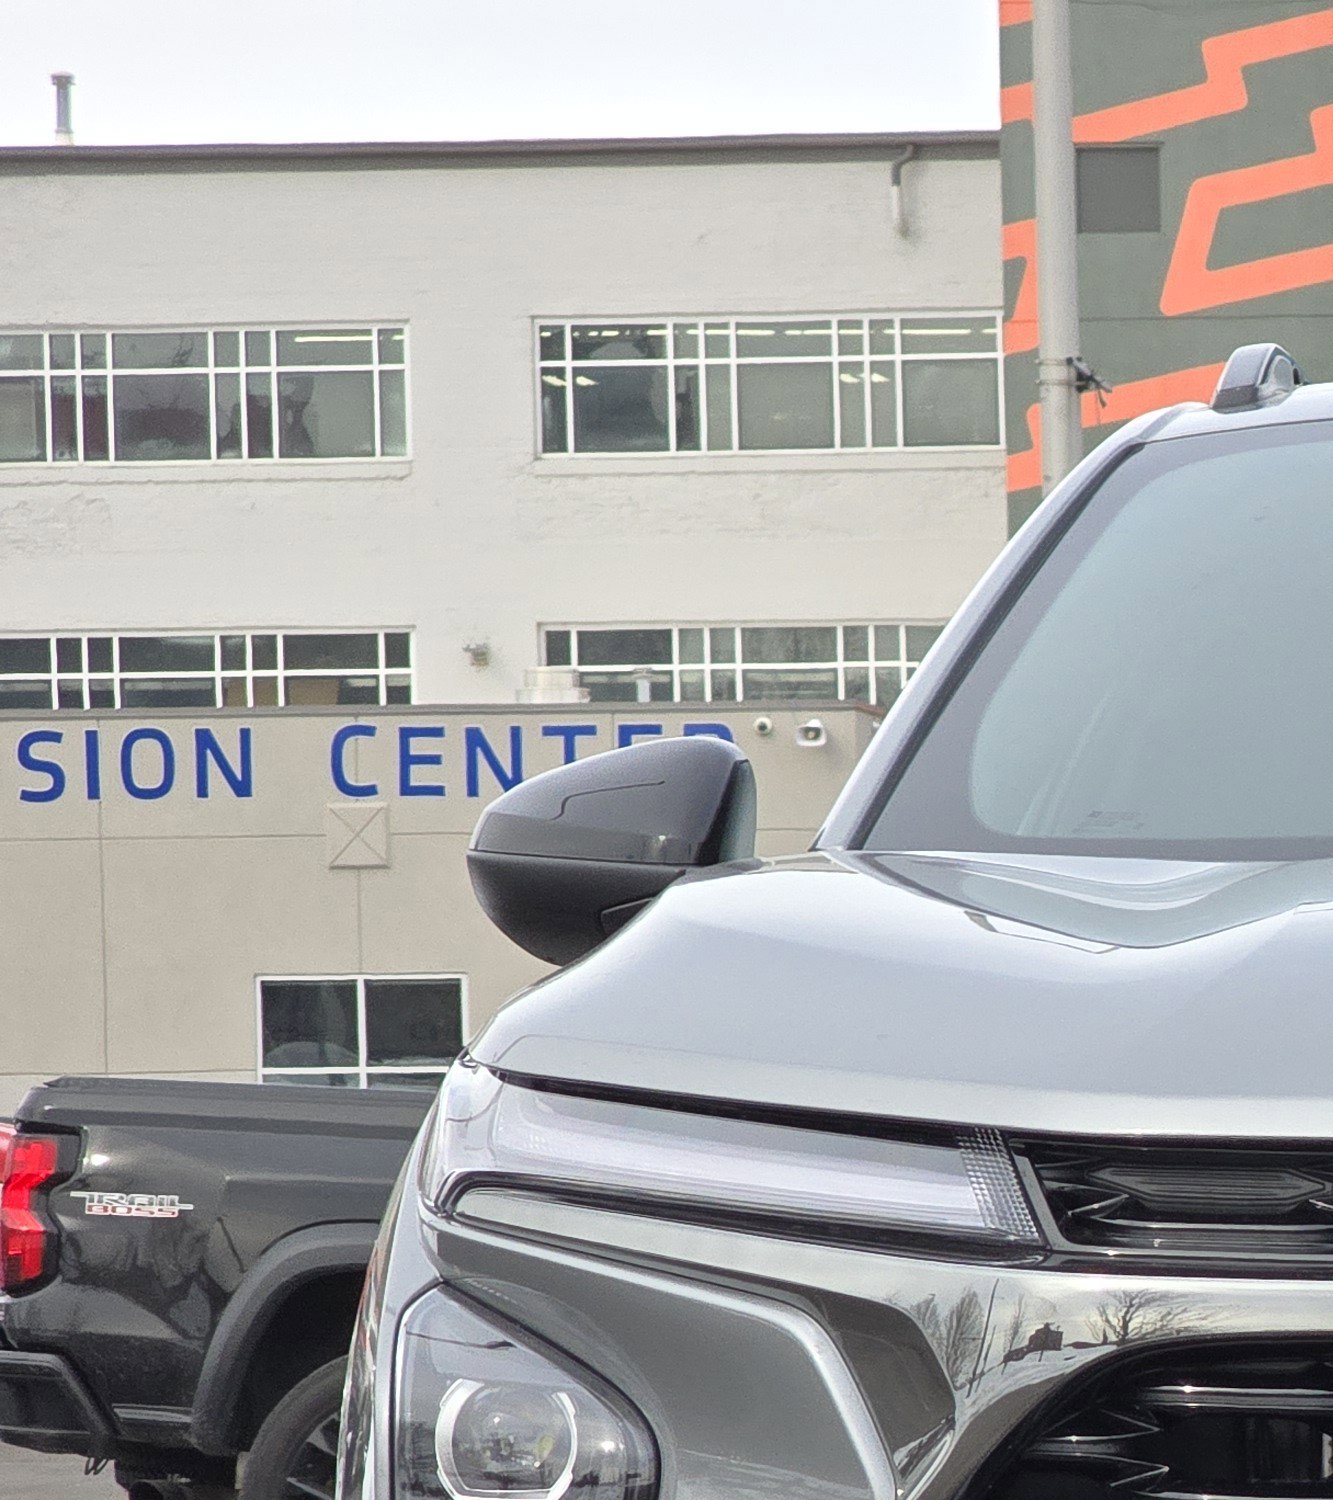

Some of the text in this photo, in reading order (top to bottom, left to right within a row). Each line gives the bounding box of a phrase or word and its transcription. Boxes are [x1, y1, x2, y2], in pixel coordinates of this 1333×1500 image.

[17, 723, 734, 803] SION CENT
[85, 1204, 179, 1218] BOSS
